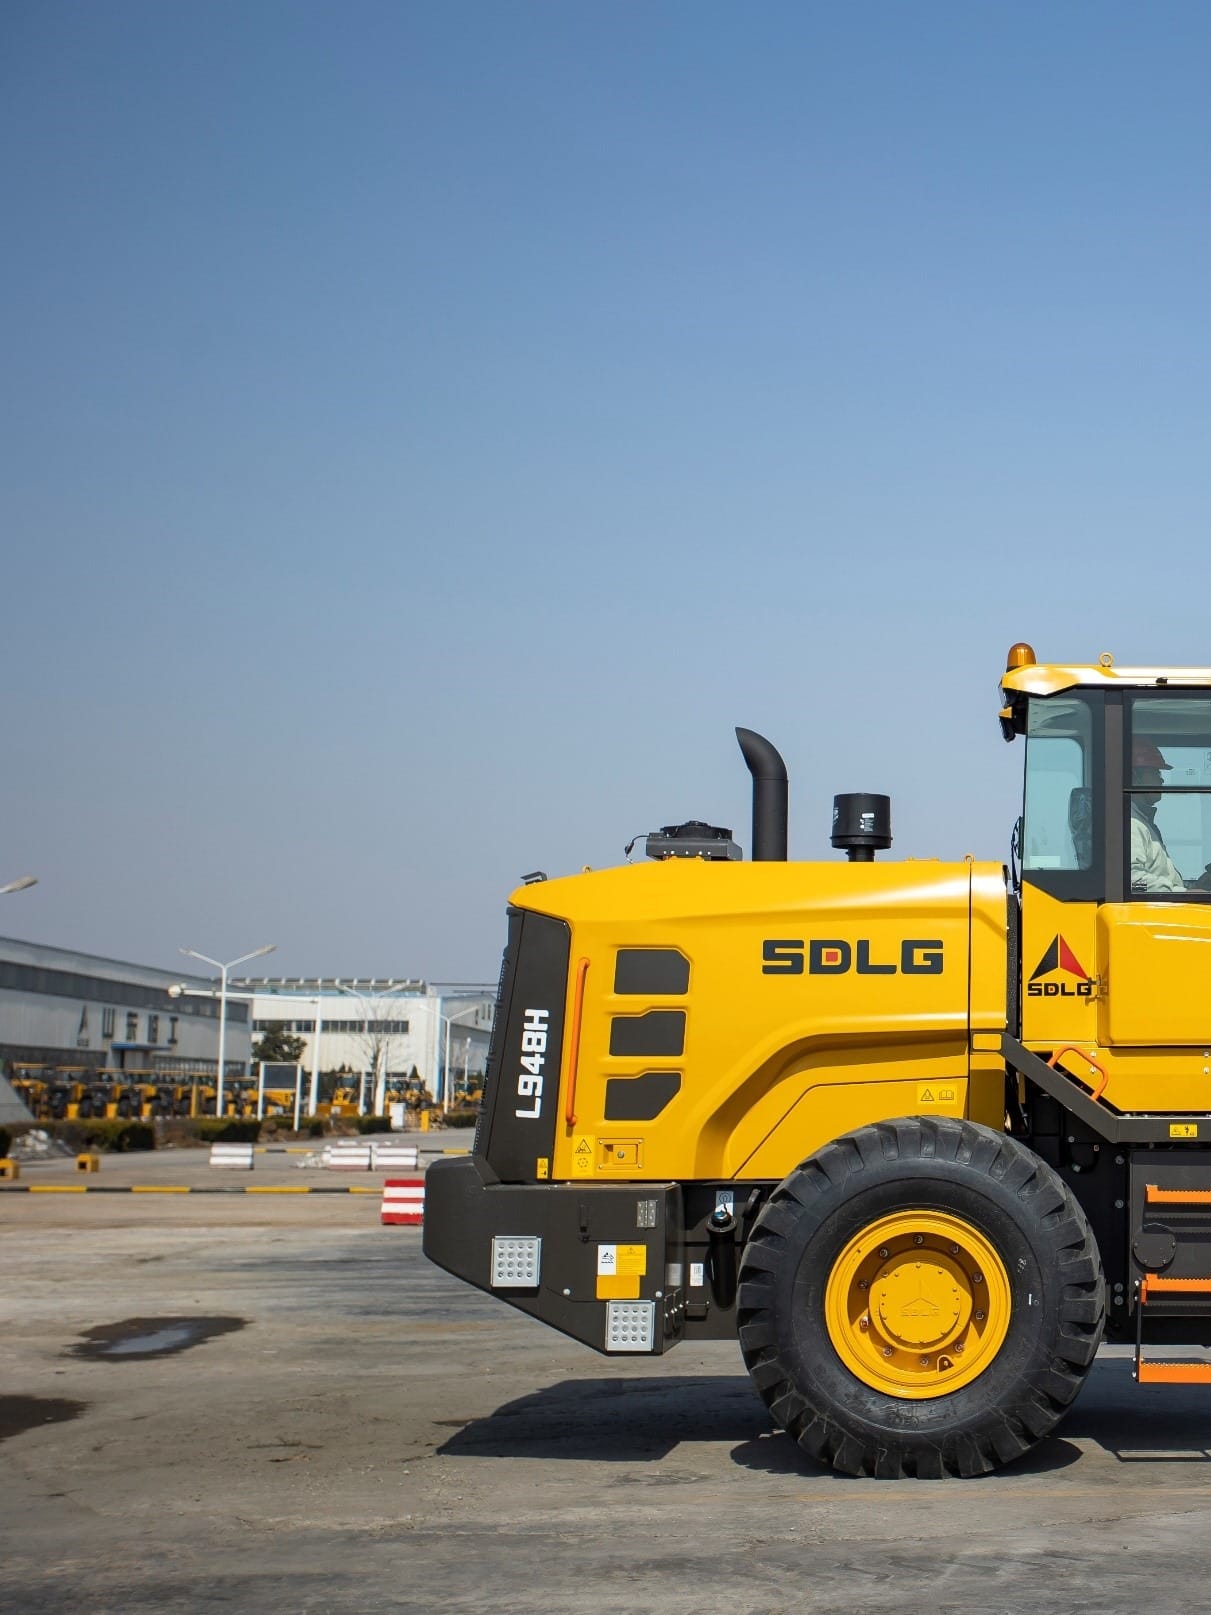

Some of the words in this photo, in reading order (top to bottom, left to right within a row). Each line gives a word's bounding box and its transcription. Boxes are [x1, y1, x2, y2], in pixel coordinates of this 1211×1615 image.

[762, 940, 943, 974] SDLG
[1028, 983, 1091, 996] SDLG
[516, 1009, 549, 1118] L948H
